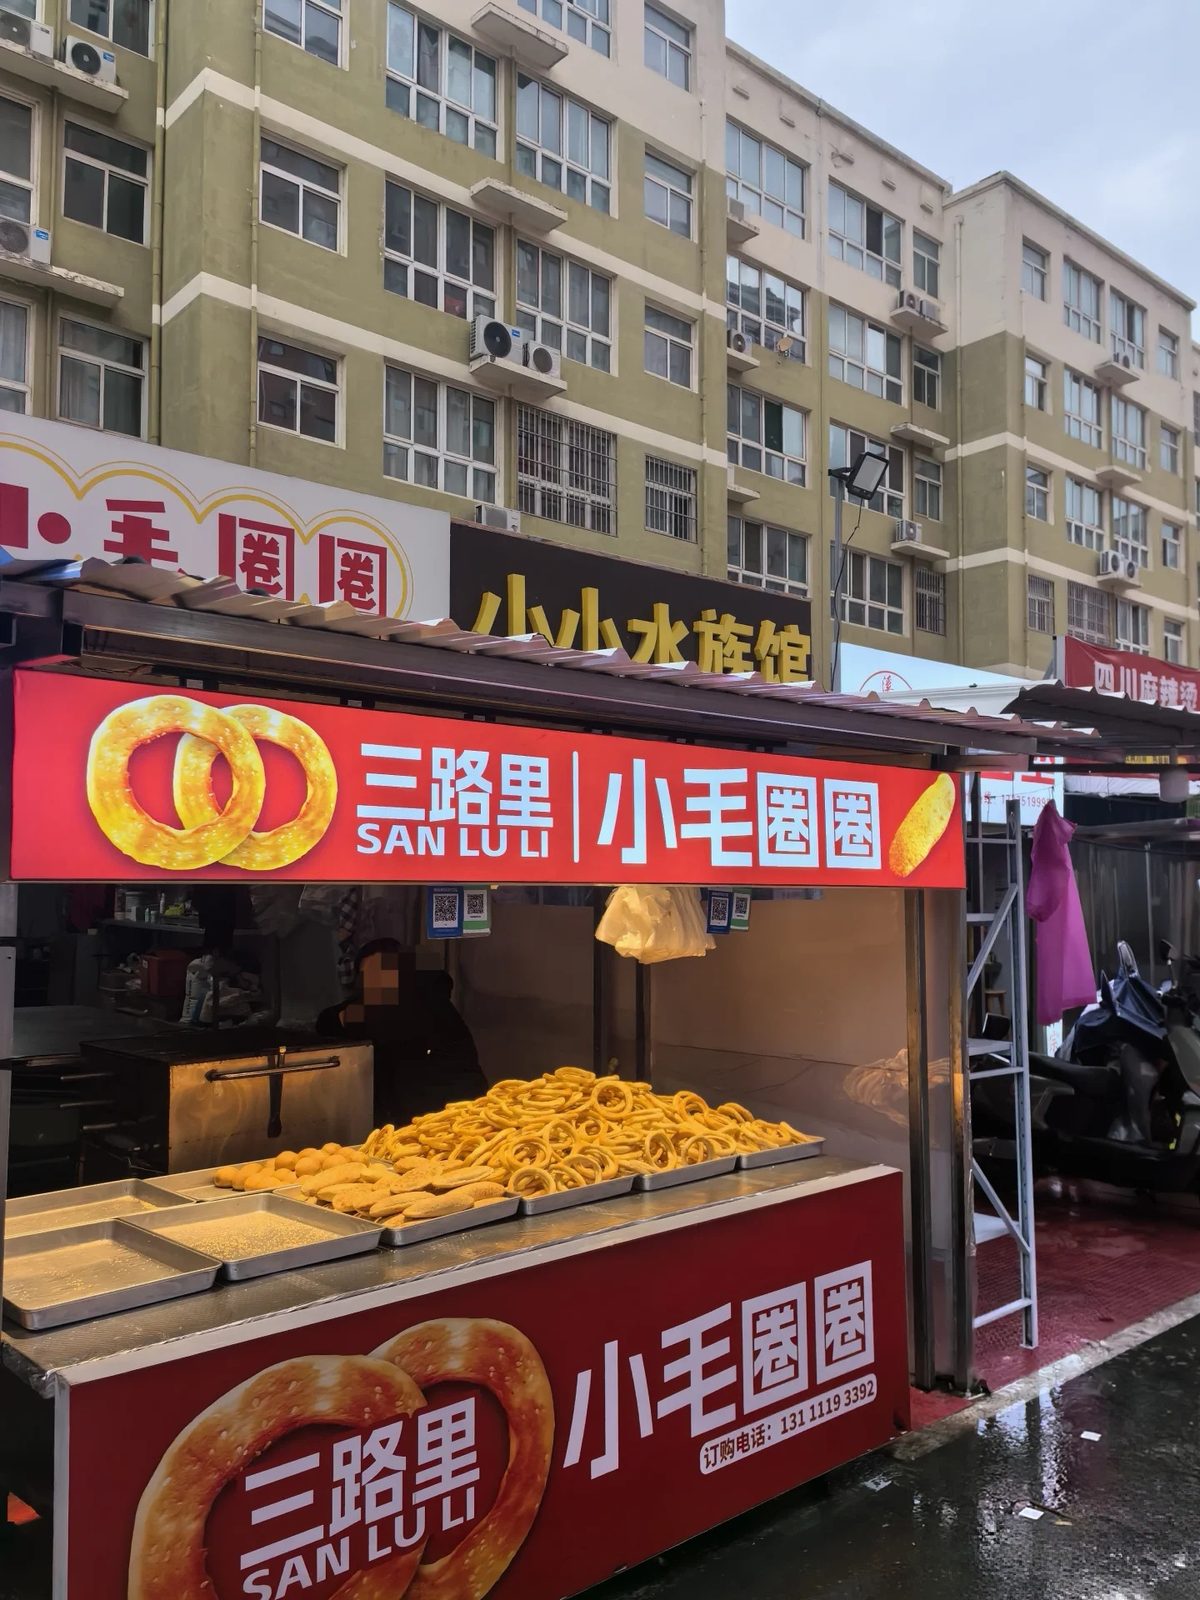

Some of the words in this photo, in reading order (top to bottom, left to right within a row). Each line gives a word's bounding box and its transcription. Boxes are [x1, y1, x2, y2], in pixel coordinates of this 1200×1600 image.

[472, 573, 811, 683] 小小水族馆
[357, 743, 553, 828] 三路里
[597, 758, 882, 869] 小毛圈圈
[357, 823, 445, 857] SAN
[459, 829, 507, 857] LU
[520, 830, 549, 858] LI
[562, 1259, 875, 1480] 小毛圈圈
[781, 1409, 806, 1435] 131
[809, 1394, 841, 1422] 1119
[844, 1380, 875, 1407] 3392
[240, 1397, 480, 1571] 三路里
[242, 1537, 350, 1600] SAN
[368, 1506, 426, 1562] LU
[442, 1486, 475, 1531] LI
